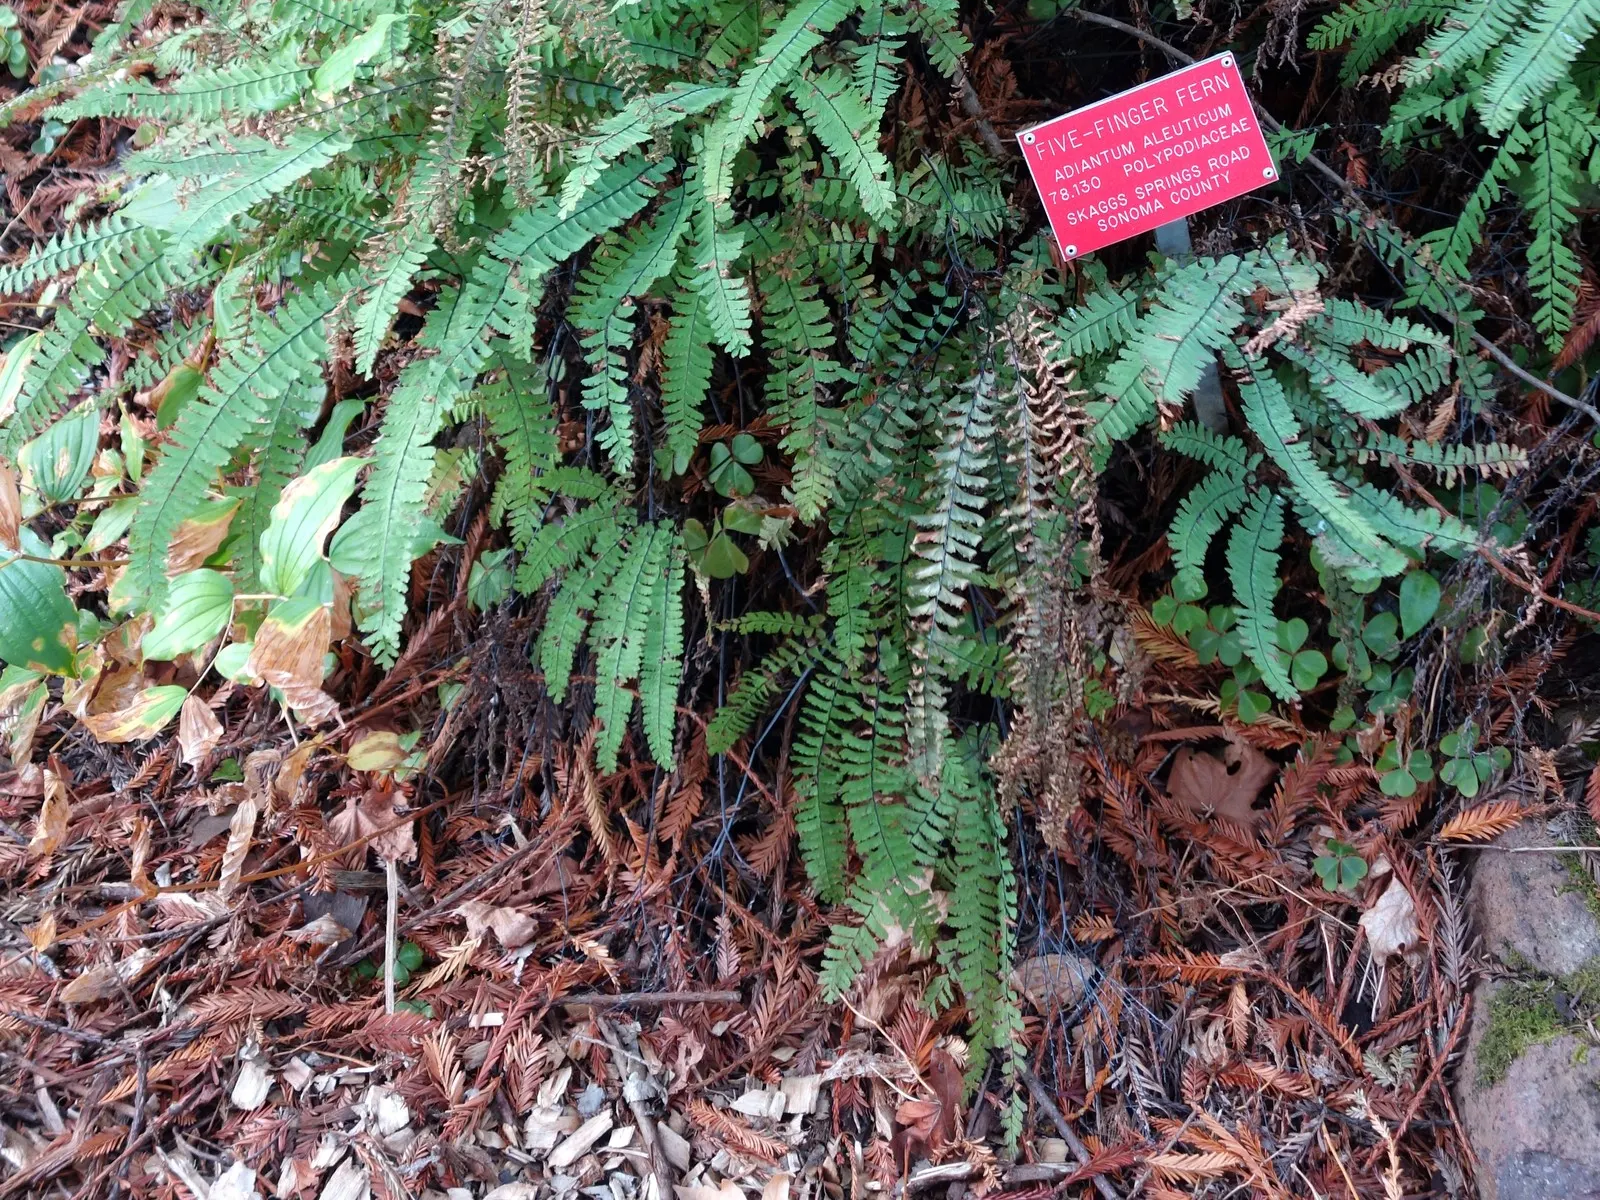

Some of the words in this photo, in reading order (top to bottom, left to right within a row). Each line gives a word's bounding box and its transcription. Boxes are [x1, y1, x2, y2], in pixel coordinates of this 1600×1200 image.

[1035, 97, 1169, 161] FIVE-FINGER
[1176, 72, 1231, 107] FERN
[1055, 142, 1136, 182] ADIANTUM
[1143, 103, 1233, 150] ALEUTICUM
[1048, 176, 1101, 205] 78.130
[1123, 117, 1252, 177] POLYPODIACEAE
[1067, 193, 1128, 226] SKAGGS
[1135, 165, 1202, 201] SPRINGS
[1208, 145, 1250, 172] ROAD
[1097, 197, 1164, 232] SONOMA
[1170, 170, 1231, 204] COUNTY
